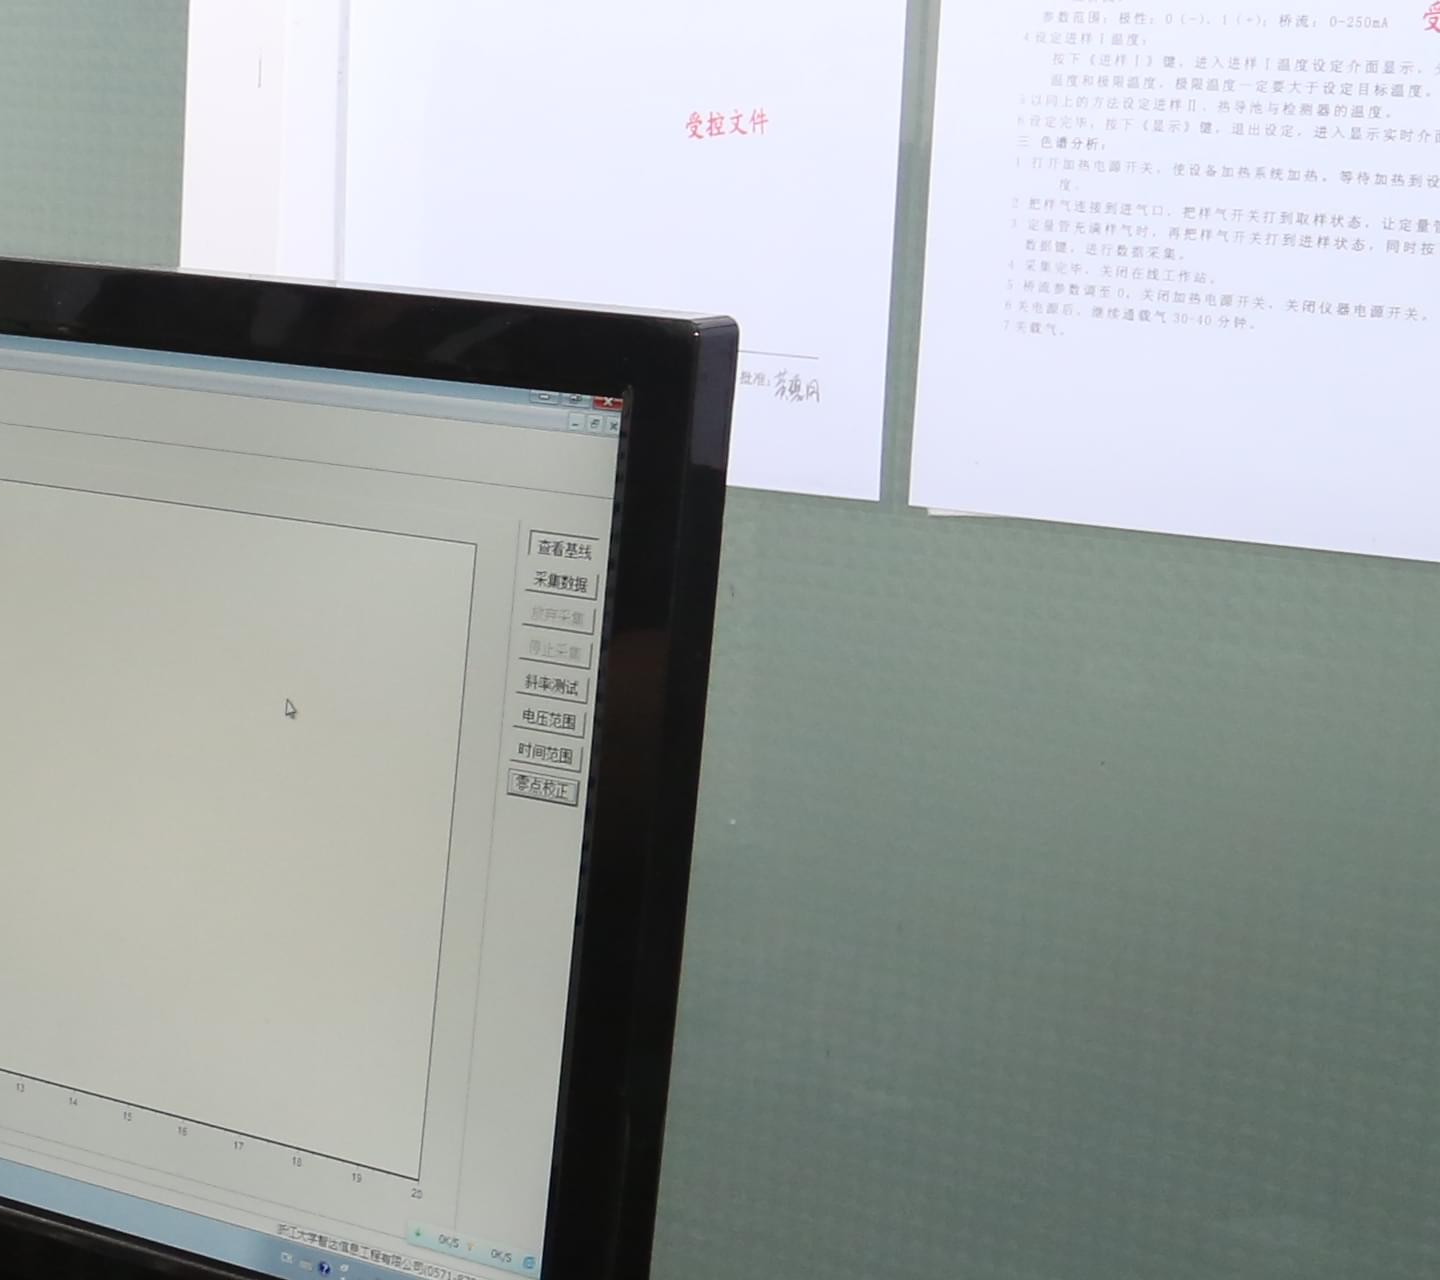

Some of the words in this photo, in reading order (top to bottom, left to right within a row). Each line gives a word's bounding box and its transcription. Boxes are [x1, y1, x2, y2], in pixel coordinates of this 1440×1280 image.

[684, 107, 770, 140] 受控文件
[537, 538, 593, 562] 查看基线
[533, 570, 589, 595] 采集数据
[524, 673, 579, 698] 斜率测试
[521, 707, 577, 732] 电压范围
[517, 742, 574, 766] 时间范围
[514, 774, 570, 800] 零点校正
